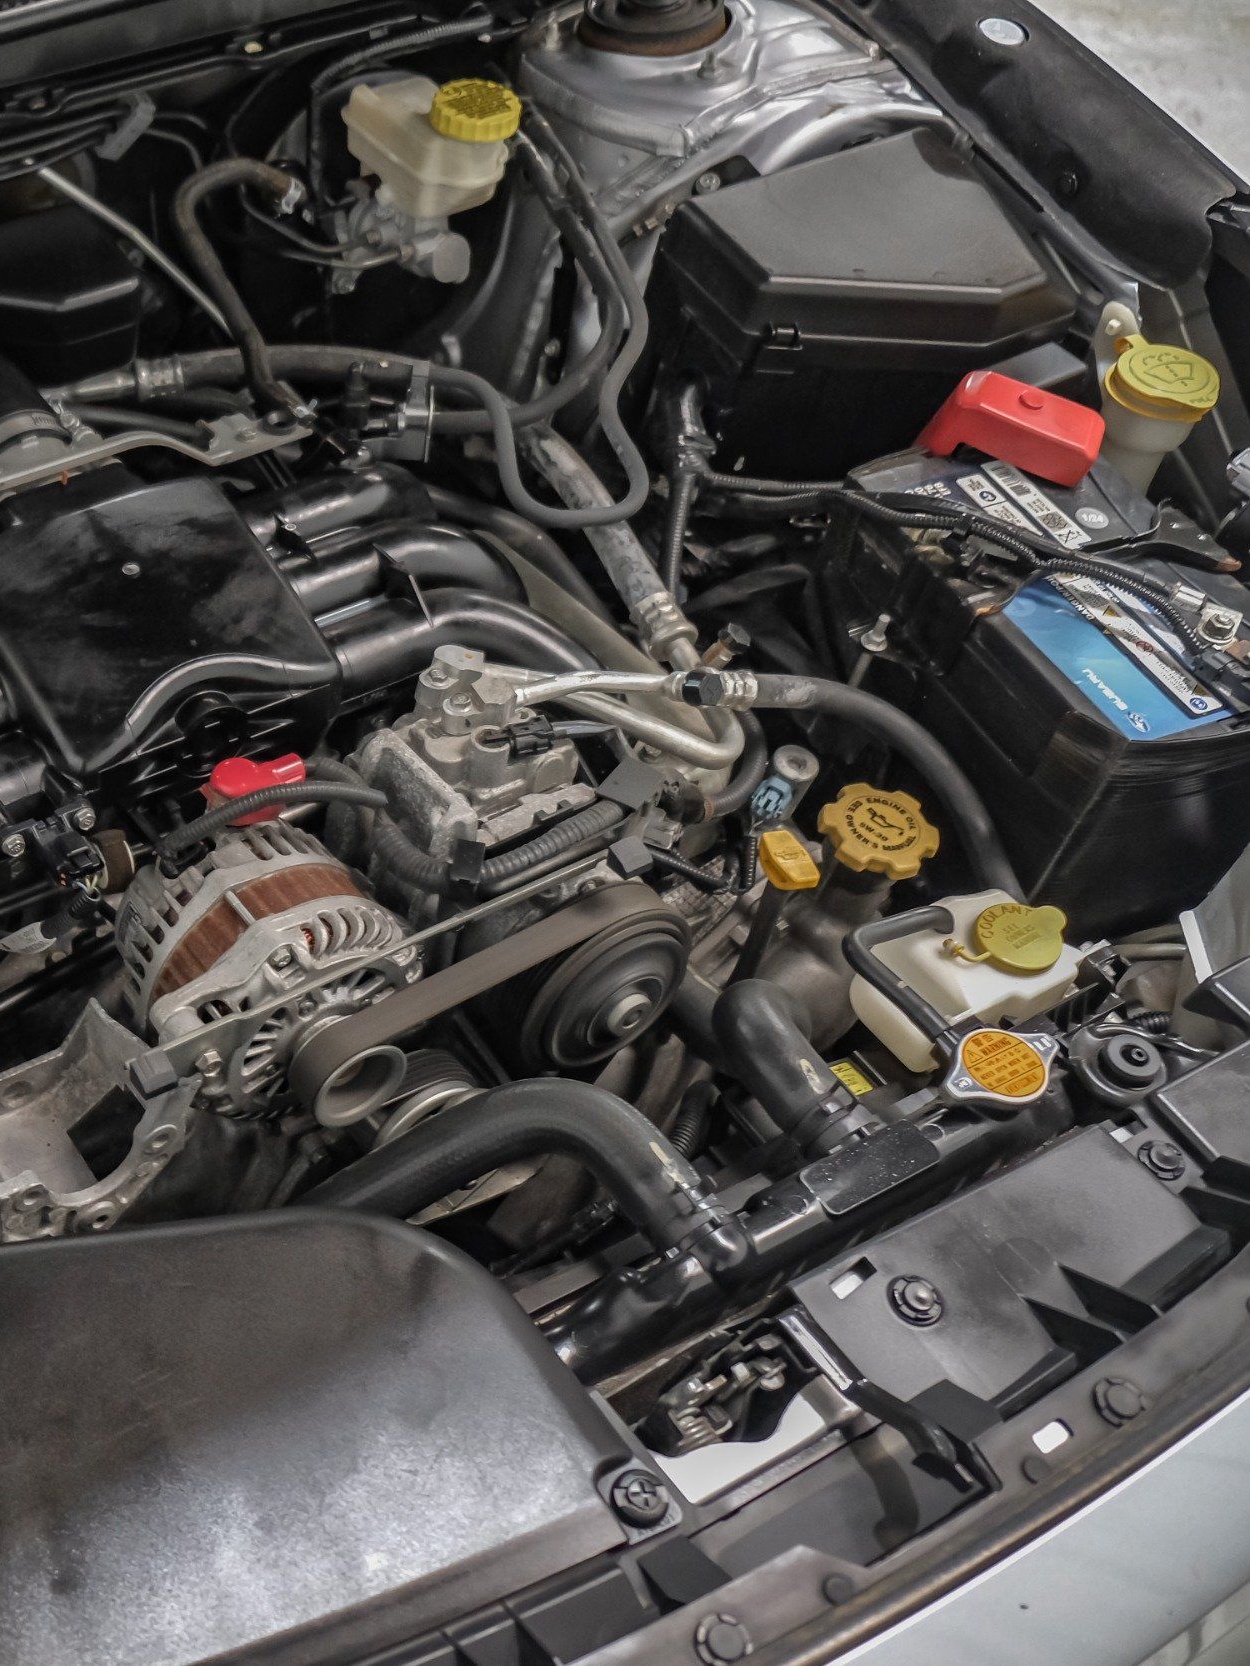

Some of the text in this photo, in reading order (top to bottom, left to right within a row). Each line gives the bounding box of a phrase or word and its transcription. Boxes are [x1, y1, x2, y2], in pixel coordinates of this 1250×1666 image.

[1082, 668, 1129, 711] SUBARU
[866, 797, 917, 830] ENGINE OIL
[979, 905, 1033, 939] COOLANT
[980, 1037, 1012, 1056] WARNING
